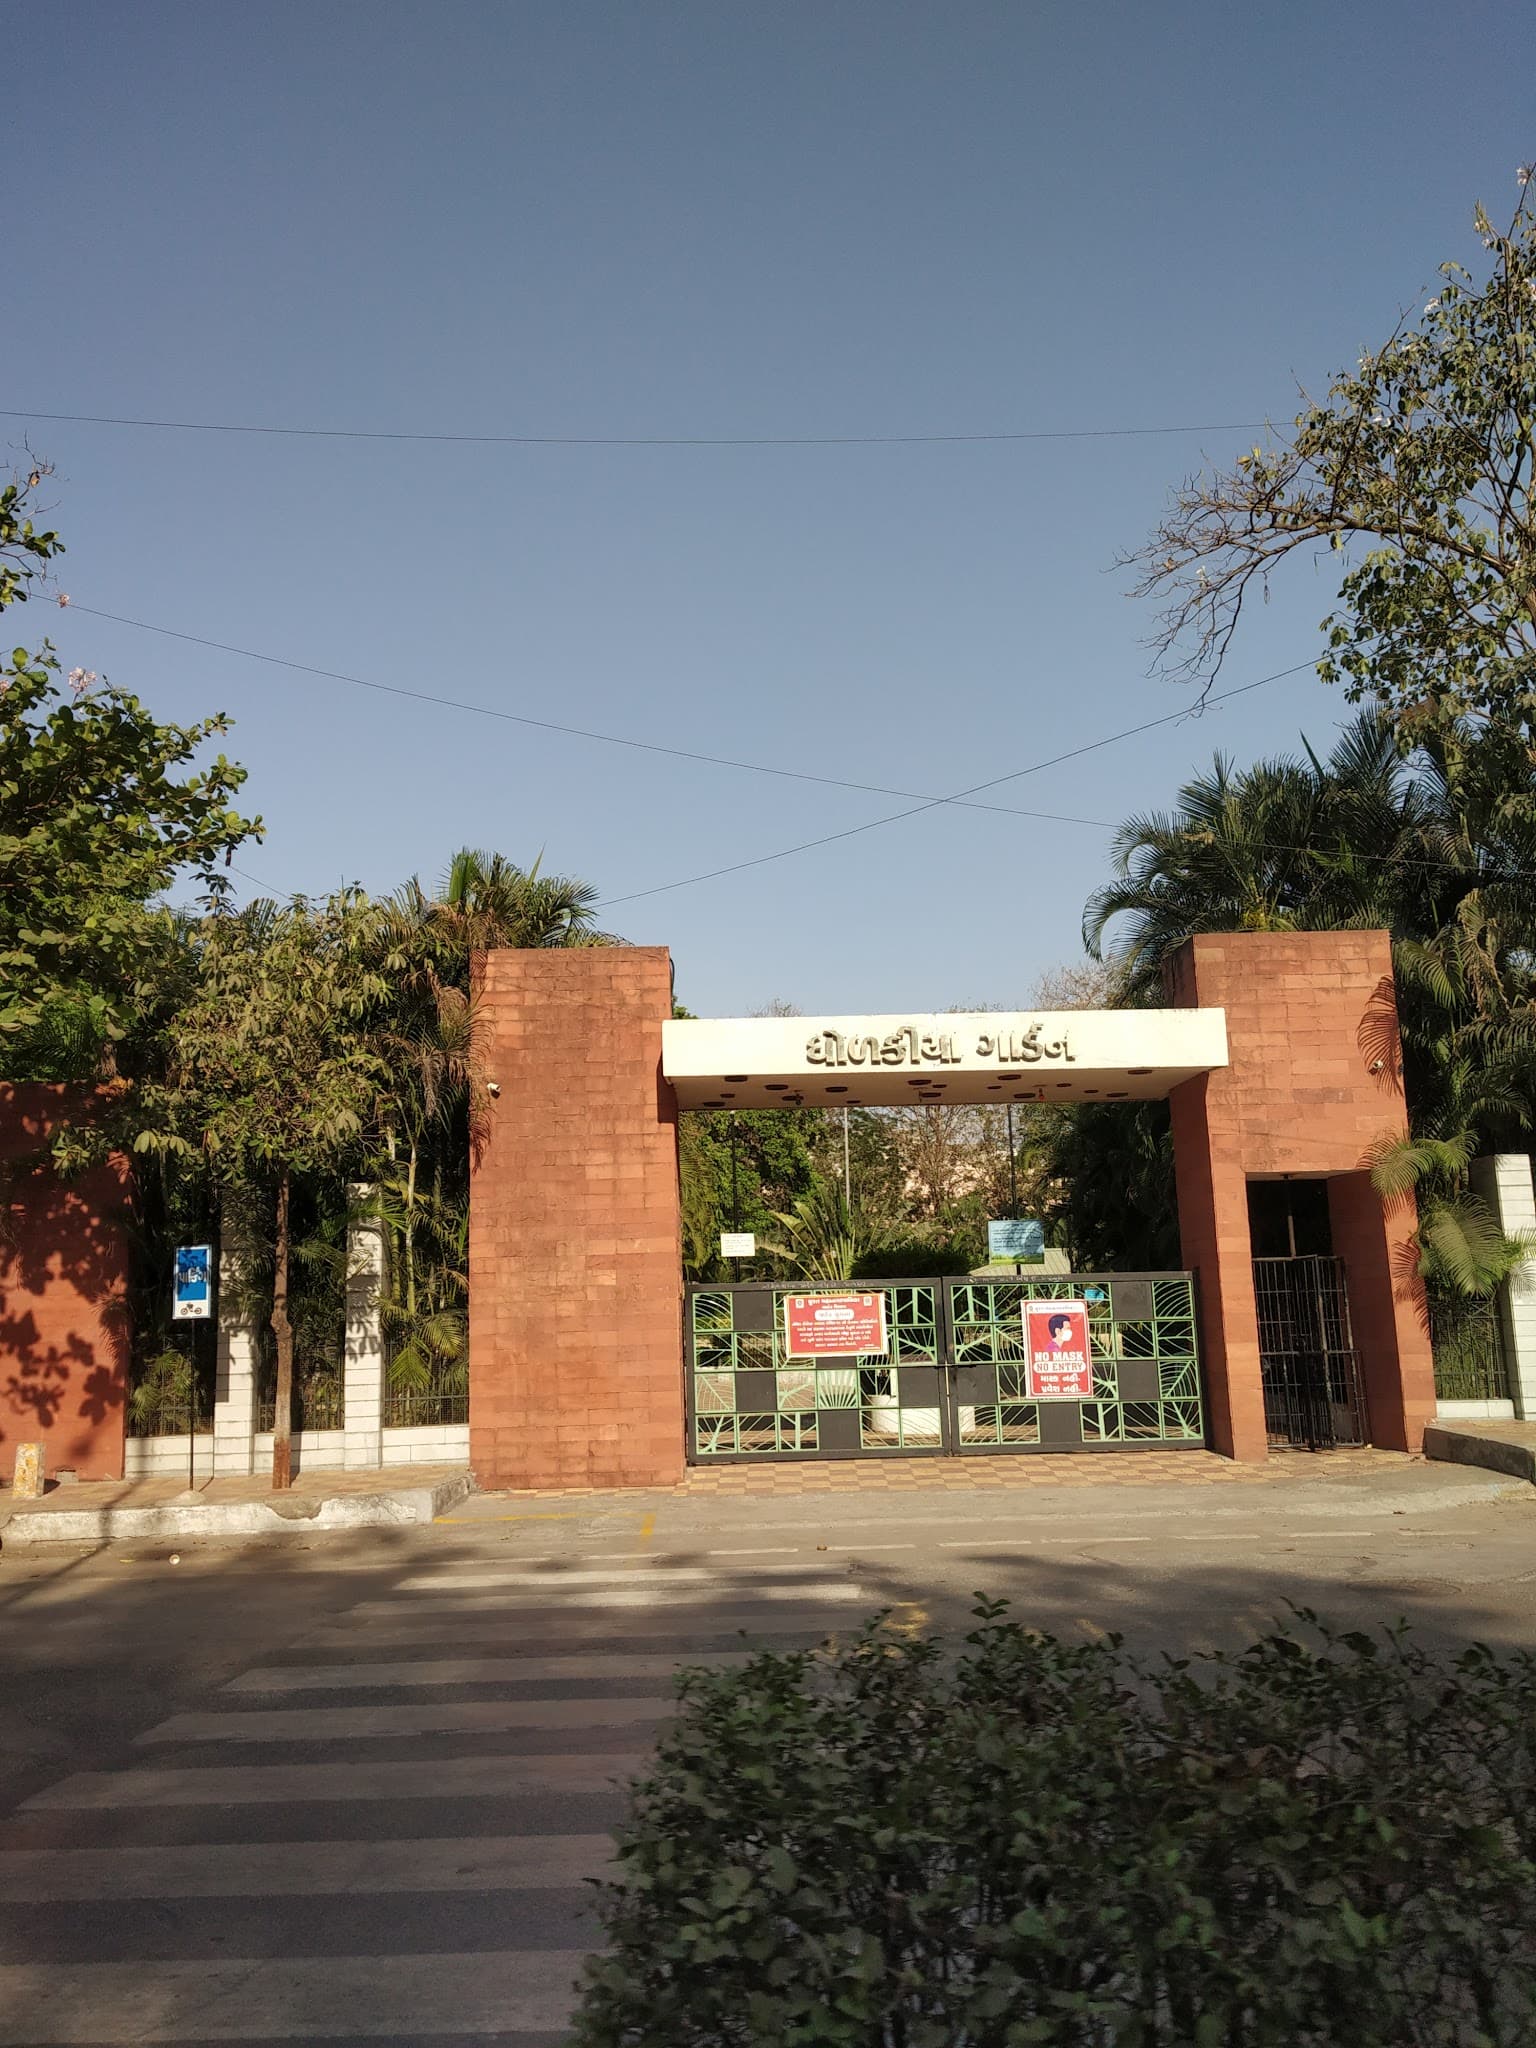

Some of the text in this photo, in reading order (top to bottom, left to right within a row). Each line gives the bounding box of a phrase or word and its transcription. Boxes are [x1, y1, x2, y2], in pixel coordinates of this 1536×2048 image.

[976, 1021, 1076, 1063] ગાર્ડન
[1034, 1351, 1084, 1361] NO MASK
[1036, 1362, 1083, 1371] NO ENTRY
